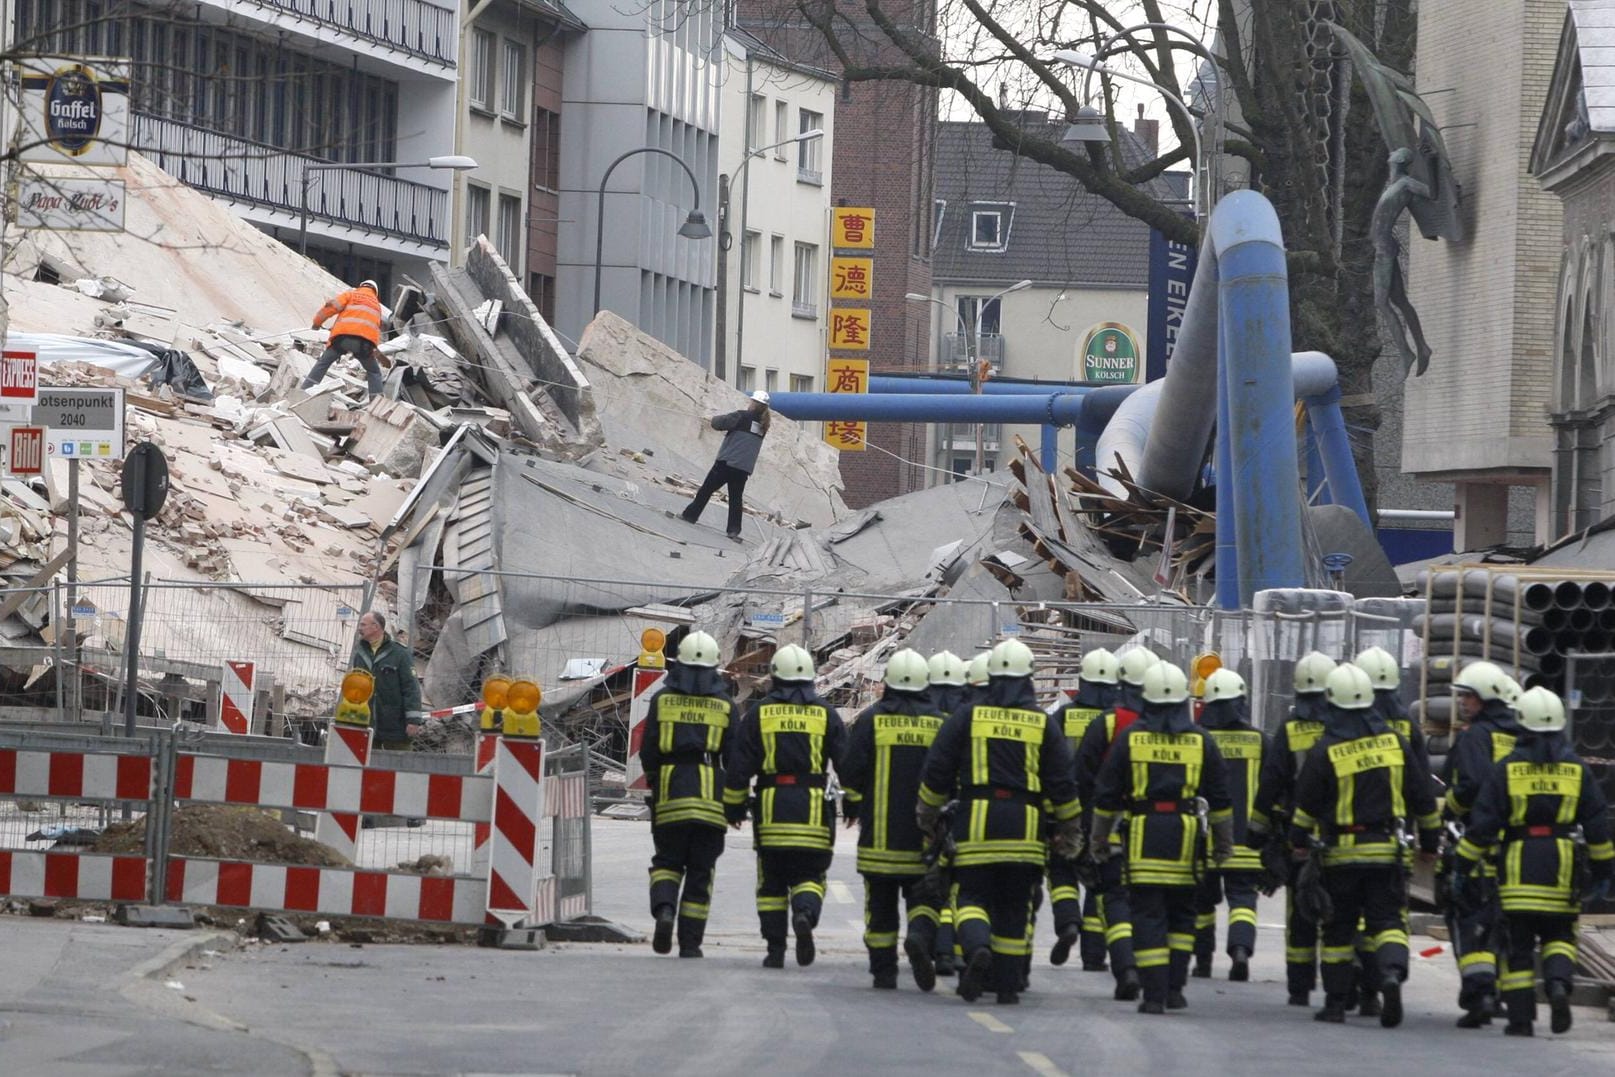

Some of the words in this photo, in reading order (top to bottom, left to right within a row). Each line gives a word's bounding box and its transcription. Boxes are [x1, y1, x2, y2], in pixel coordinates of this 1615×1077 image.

[51, 99, 97, 119] Gaffel
[24, 192, 62, 213] Papa
[2, 358, 34, 388] EXPRESS
[38, 395, 113, 410] otsenpunkt
[60, 413, 86, 426] 2040
[13, 432, 41, 469] Bild
[664, 696, 724, 711] FEUERWEHR
[680, 711, 705, 722] KÖLN
[763, 706, 823, 718] FEUERWEHR
[977, 708, 1041, 725] FEUERWEHR
[780, 719, 806, 731] KÖLN
[877, 717, 939, 730] FEUERWEHR
[896, 731, 924, 744] KÖLN
[993, 725, 1021, 737] KÖLN
[1133, 734, 1198, 746] FEUERWEHR
[1333, 736, 1394, 758] FEUERWEHR
[1152, 748, 1181, 760] KÖLN
[1356, 754, 1384, 769] KÖLN
[1513, 763, 1576, 776] FEUERWEHR
[1531, 780, 1558, 792] KÖLN
